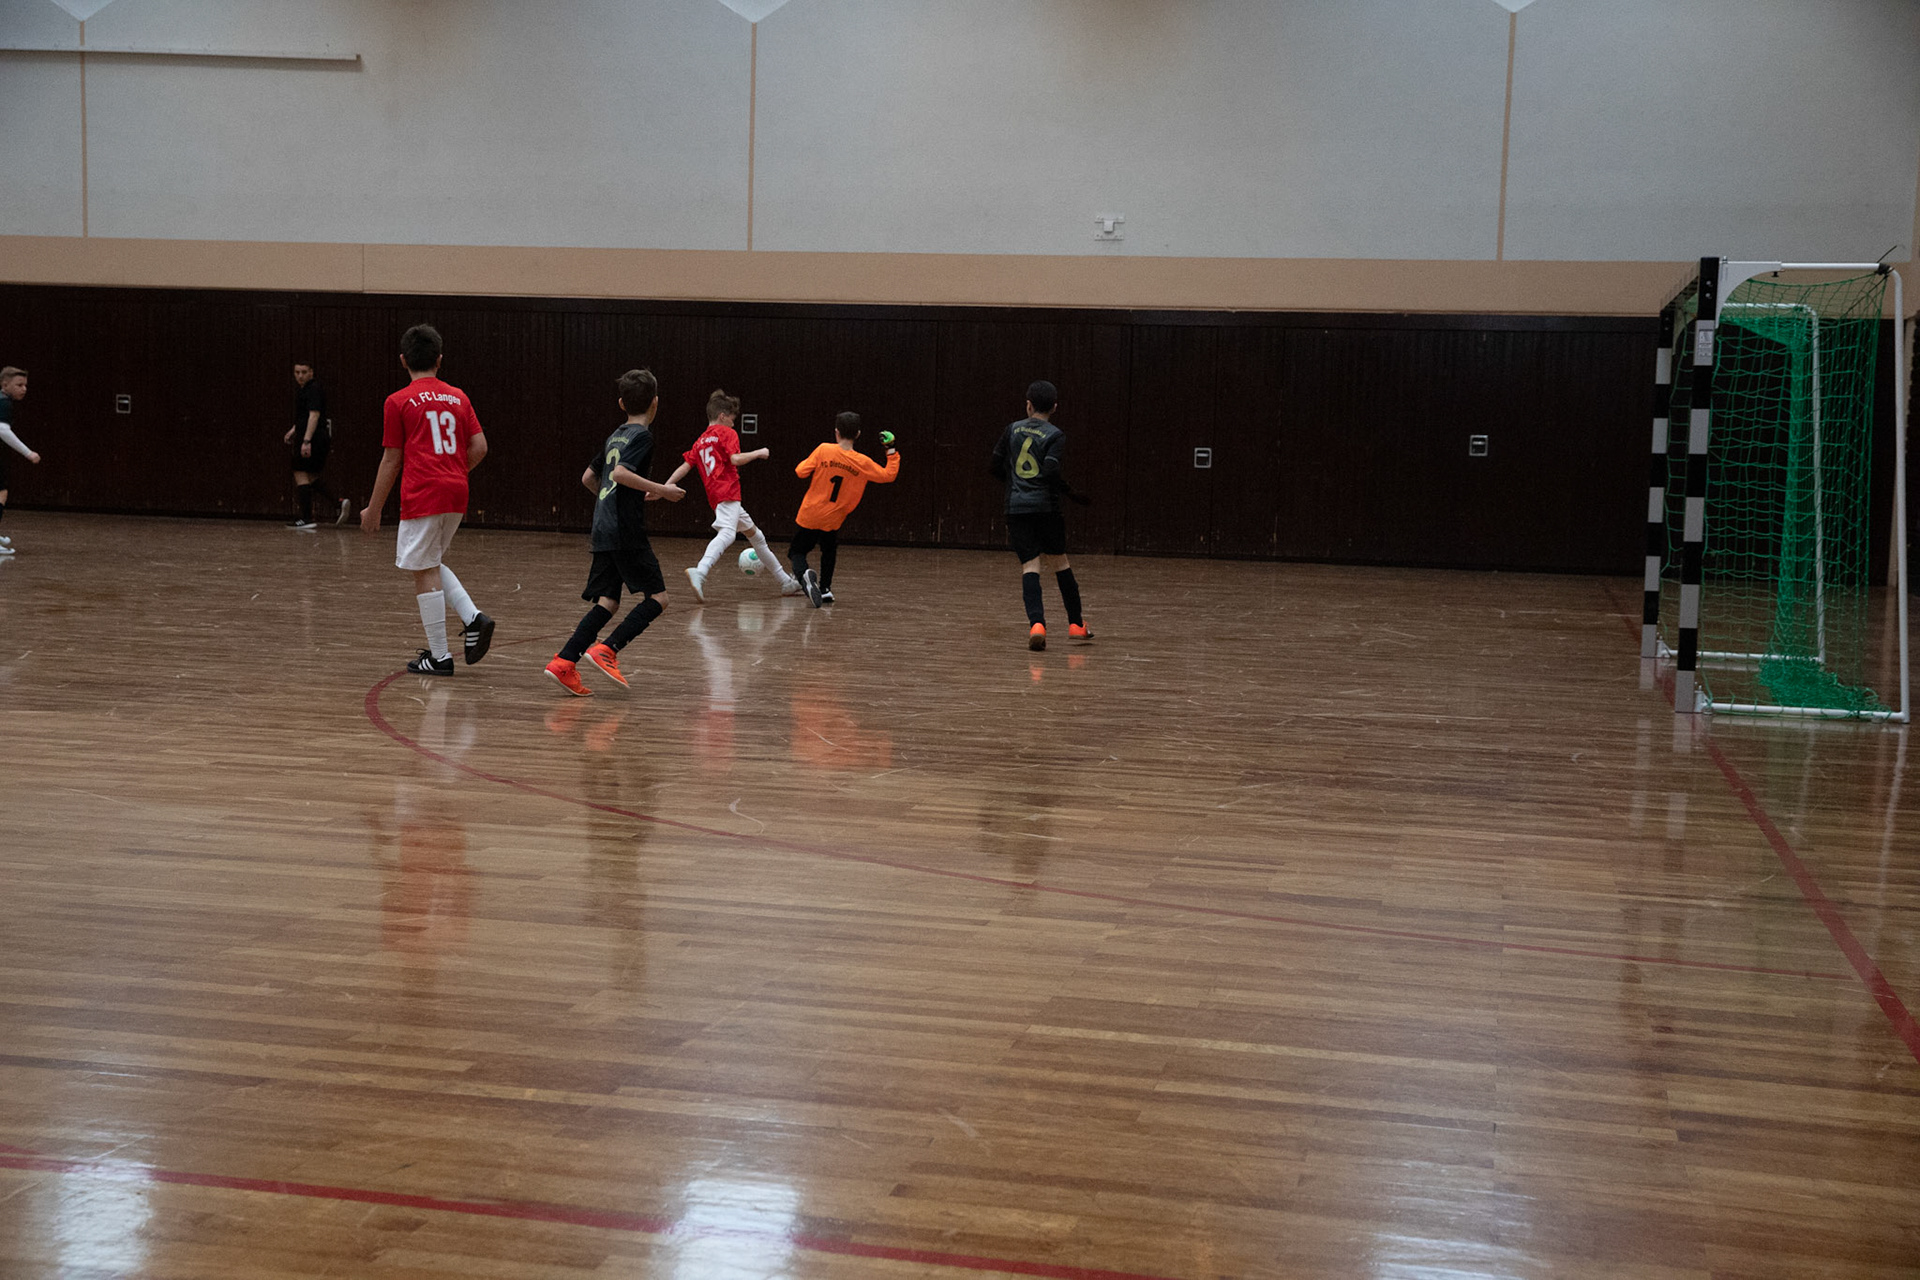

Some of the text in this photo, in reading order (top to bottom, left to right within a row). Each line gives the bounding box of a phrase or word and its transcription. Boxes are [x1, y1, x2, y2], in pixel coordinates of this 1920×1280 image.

[409, 391, 461, 407] 1. FC Langen
[425, 410, 457, 455] 13
[599, 448, 621, 501] 3
[699, 446, 716, 477] 15
[1015, 437, 1040, 479] 6
[829, 475, 844, 503] 1
